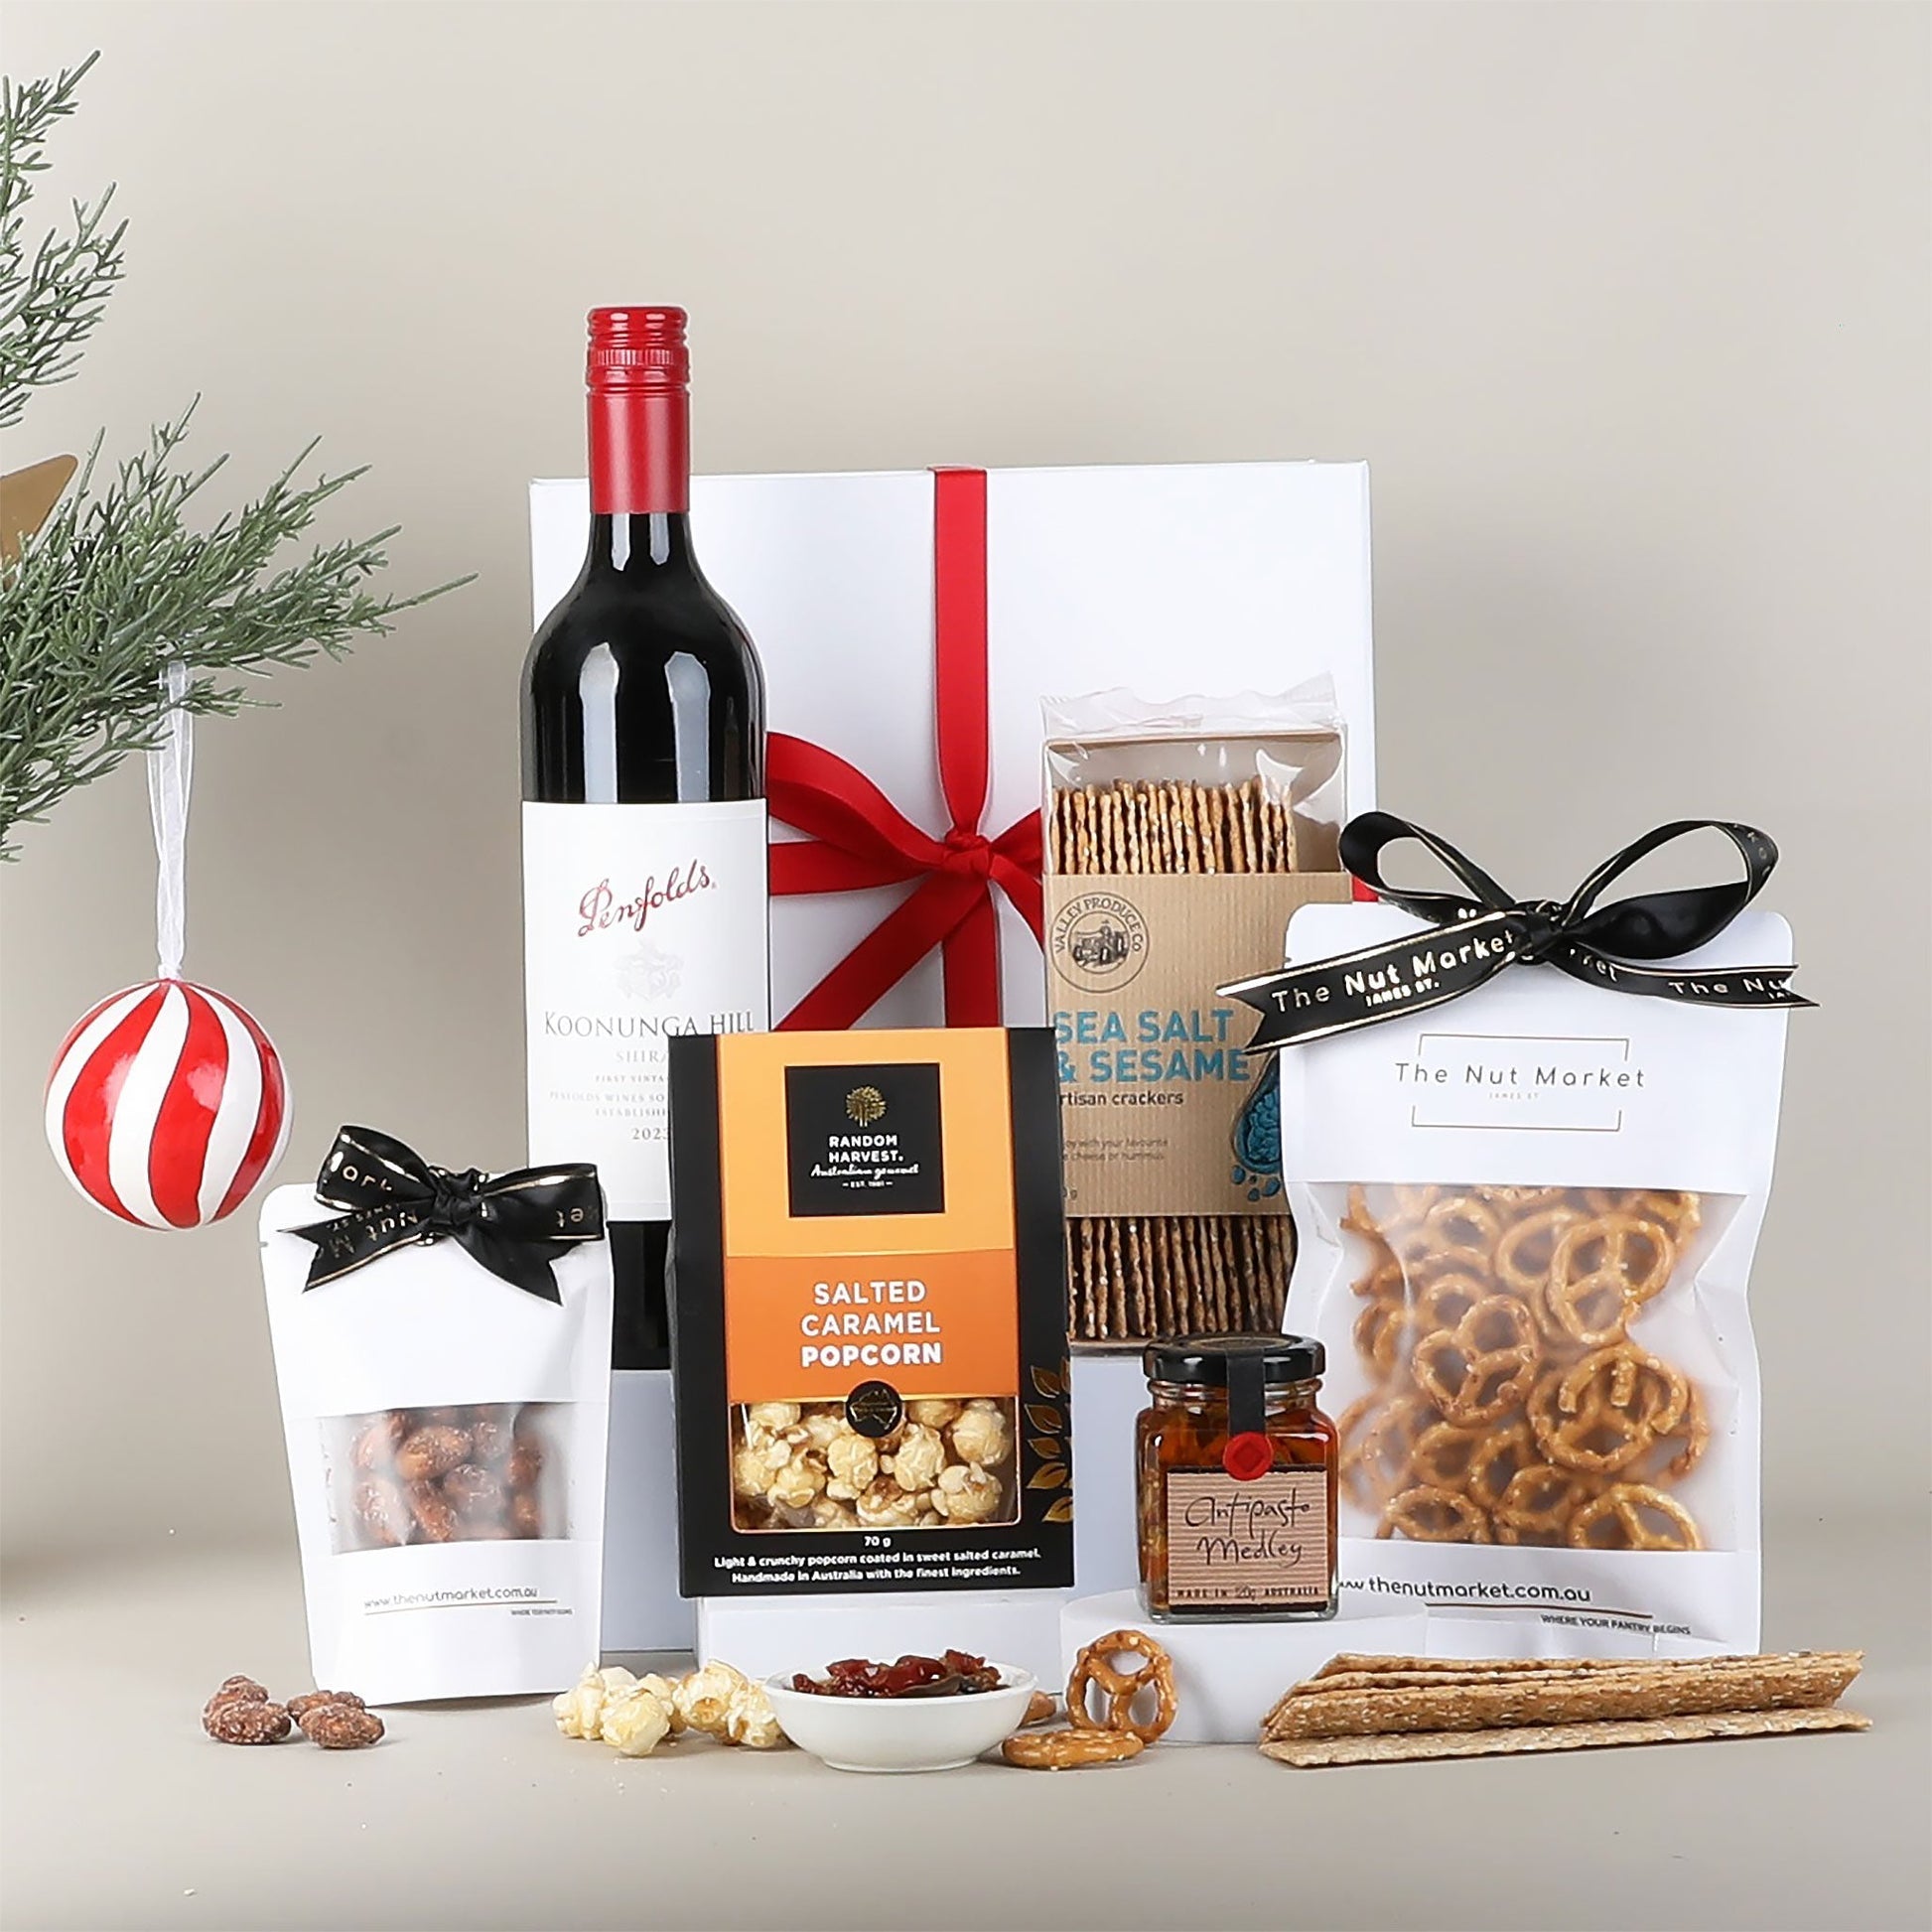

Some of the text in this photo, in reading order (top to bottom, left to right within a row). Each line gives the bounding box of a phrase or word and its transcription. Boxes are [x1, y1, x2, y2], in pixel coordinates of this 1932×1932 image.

[1054, 901, 1082, 953] VALLEY
[1083, 897, 1142, 933] PRODUCE
[1272, 930, 1515, 1013] The Nut Market
[1668, 977, 1788, 995] The Nu
[544, 1011, 756, 1038] KOONUNGA HILL
[1053, 1009, 1234, 1045] SEA SALT
[1058, 1048, 1251, 1083] & SESAME
[1395, 1062, 1645, 1088] The Nut Market
[1059, 1090, 1184, 1106] rtisan crackers
[828, 1134, 898, 1148] RANDOM
[813, 1280, 927, 1306] SALTED
[800, 1311, 941, 1337] CARAMEL
[800, 1341, 942, 1368] POPCORN
[864, 1536, 892, 1548] 70 g
[1196, 1529, 1305, 1569] Medley
[714, 1556, 745, 1570] Light
[747, 1556, 757, 1567] &
[759, 1555, 806, 1569] crunchy
[807, 1555, 858, 1568] popcorn
[860, 1552, 899, 1565] coated
[901, 1551, 914, 1563] in
[916, 1551, 951, 1563] sweet
[953, 1549, 990, 1562] salted
[732, 1565, 1022, 1584] Handmade in Australia with the finest ingredients.
[1264, 1586, 1319, 1596] AUSTRALIA
[1540, 1614, 1579, 1626] WHERE
[1580, 1617, 1610, 1627] YOUR
[1611, 1620, 1650, 1632] PANTRY
